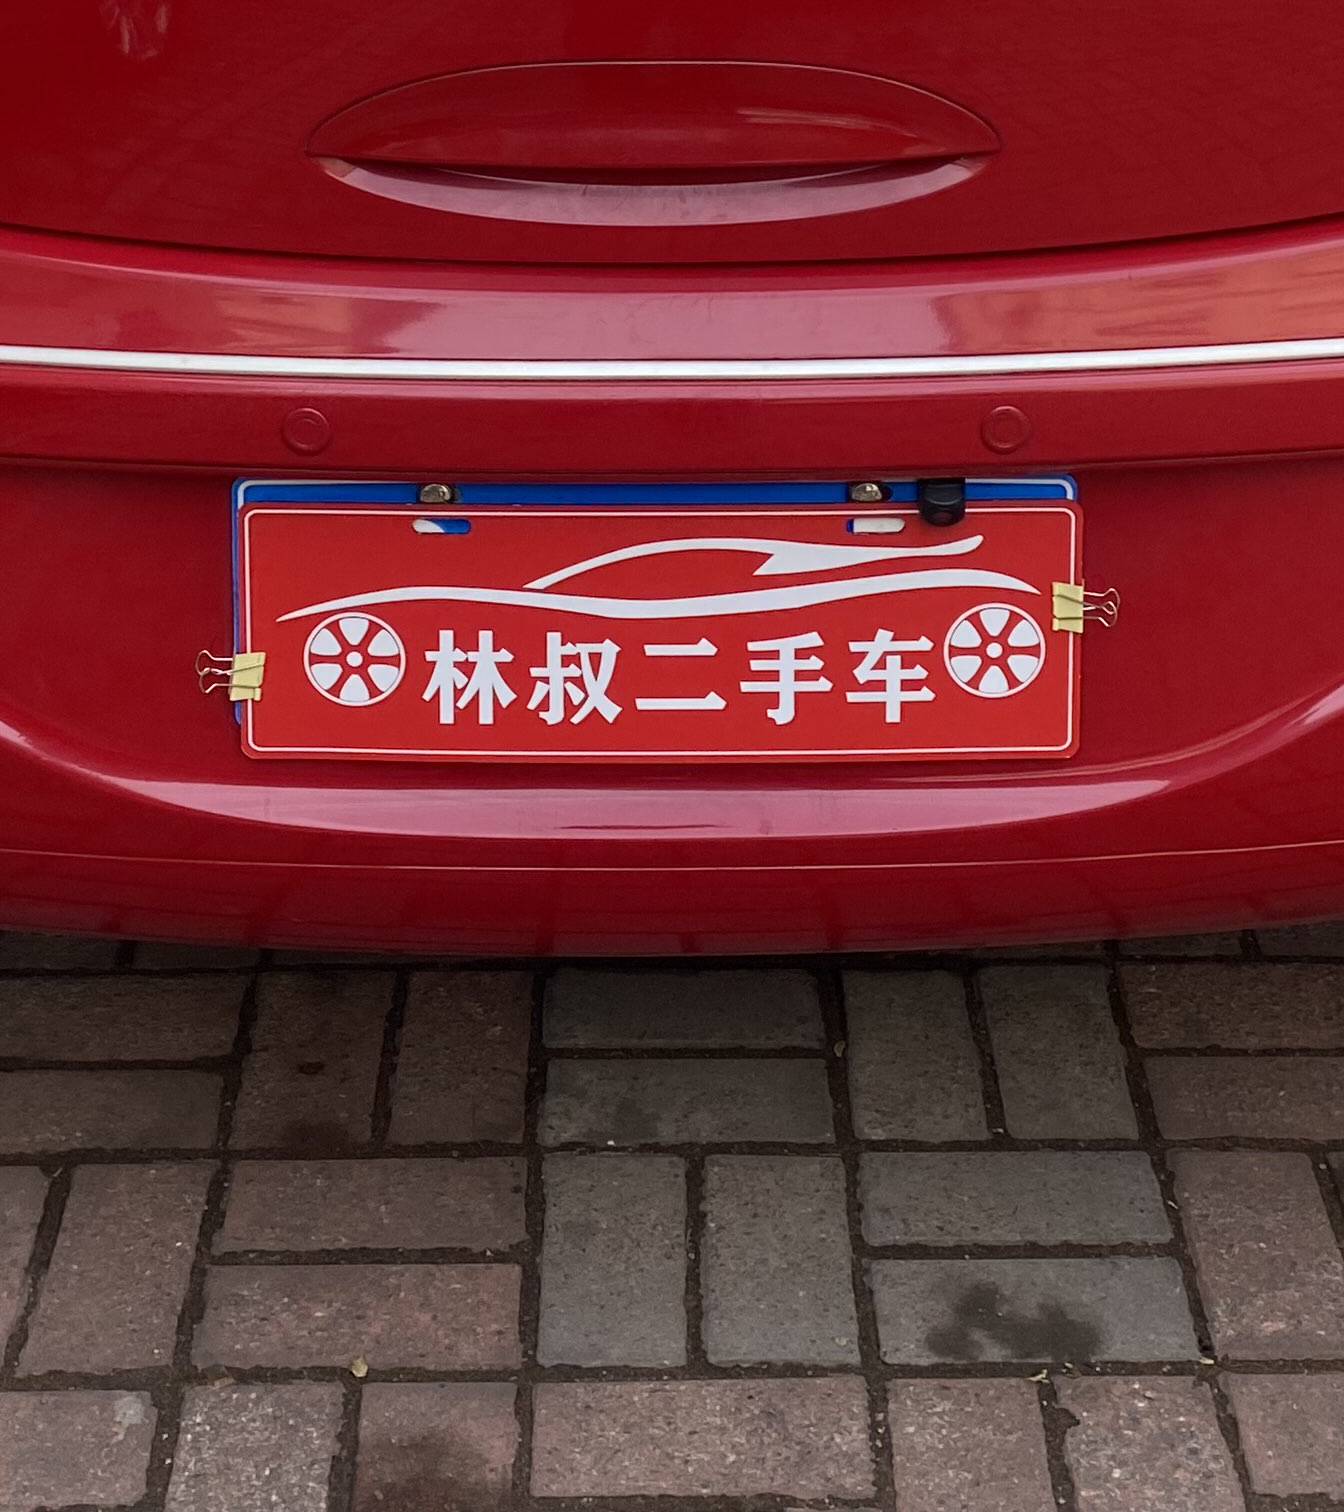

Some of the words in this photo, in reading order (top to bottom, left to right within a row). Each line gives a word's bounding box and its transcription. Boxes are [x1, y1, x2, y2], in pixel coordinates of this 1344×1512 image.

[422, 628, 937, 725] 林叔二手车
